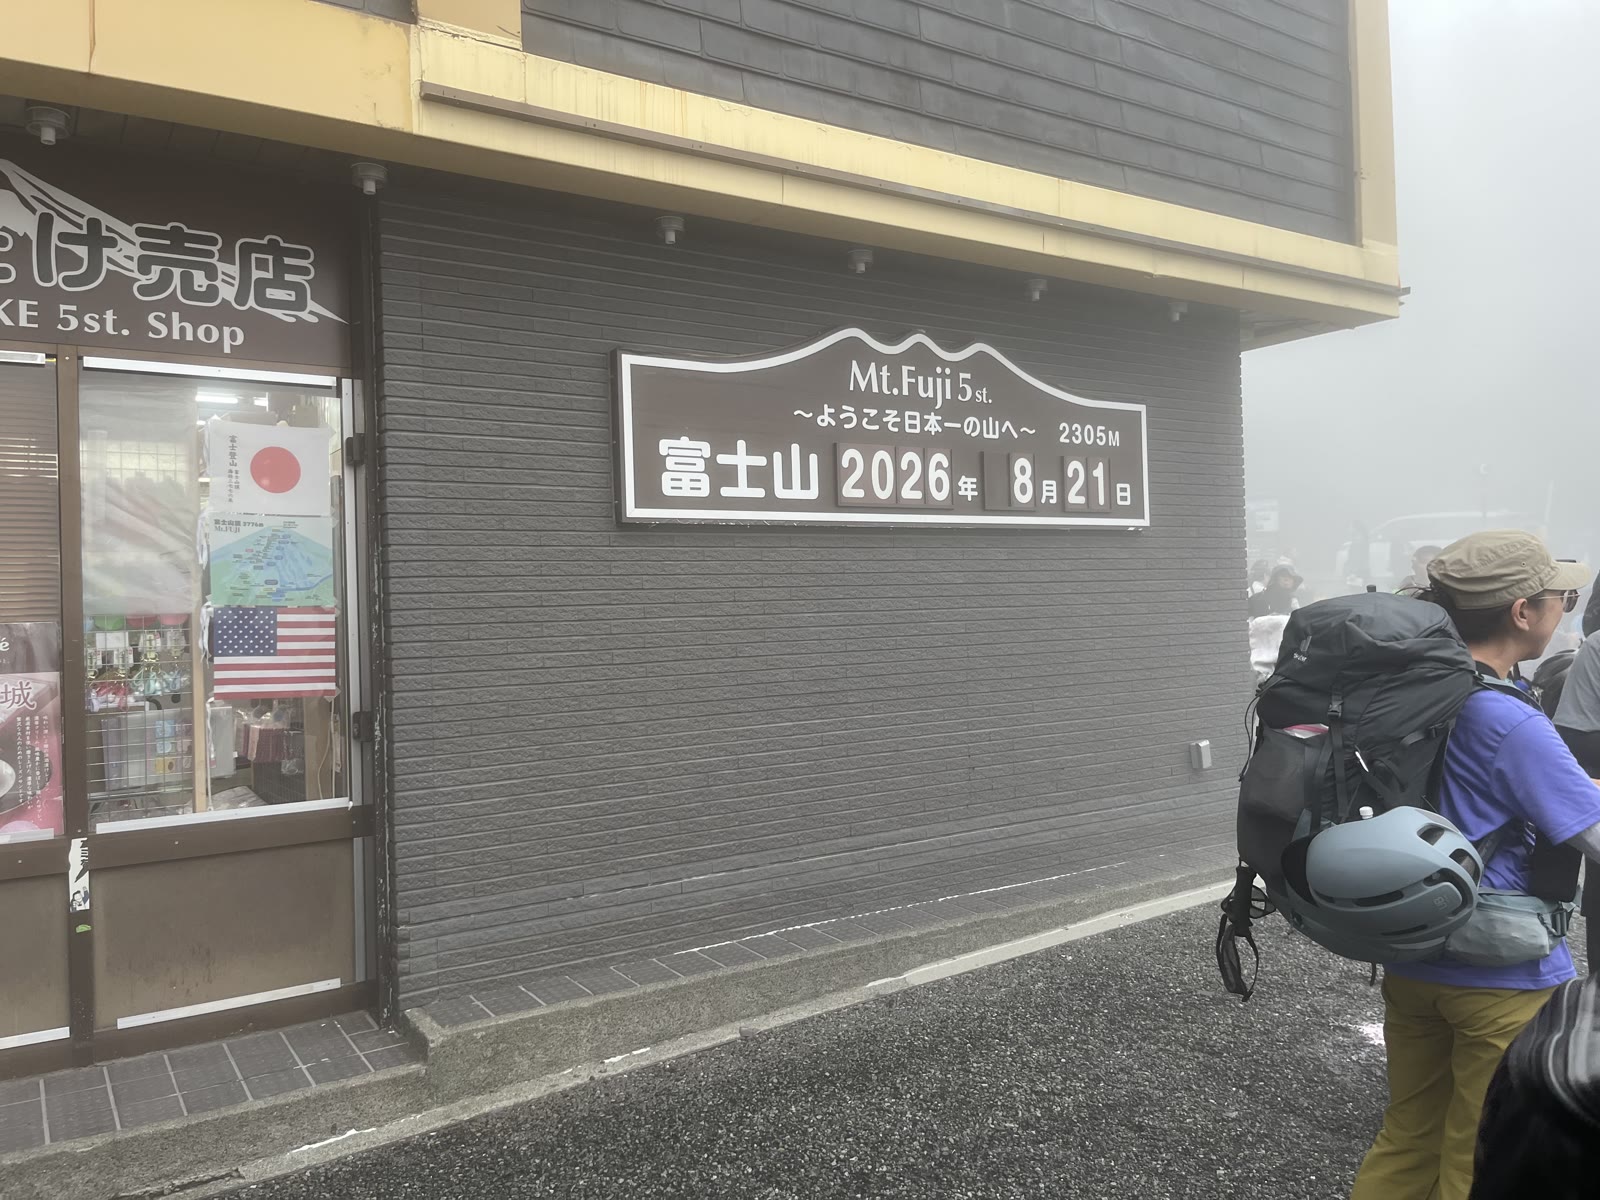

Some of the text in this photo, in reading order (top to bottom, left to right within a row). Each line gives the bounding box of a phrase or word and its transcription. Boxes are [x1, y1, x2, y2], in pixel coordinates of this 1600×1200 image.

[0, 210, 315, 315] け売店
[57, 304, 130, 336] 5st.
[148, 311, 245, 353] Shop
[849, 359, 952, 410] Mt.Fuji
[1059, 421, 1120, 447] 2305M
[659, 436, 819, 500] 富士山
